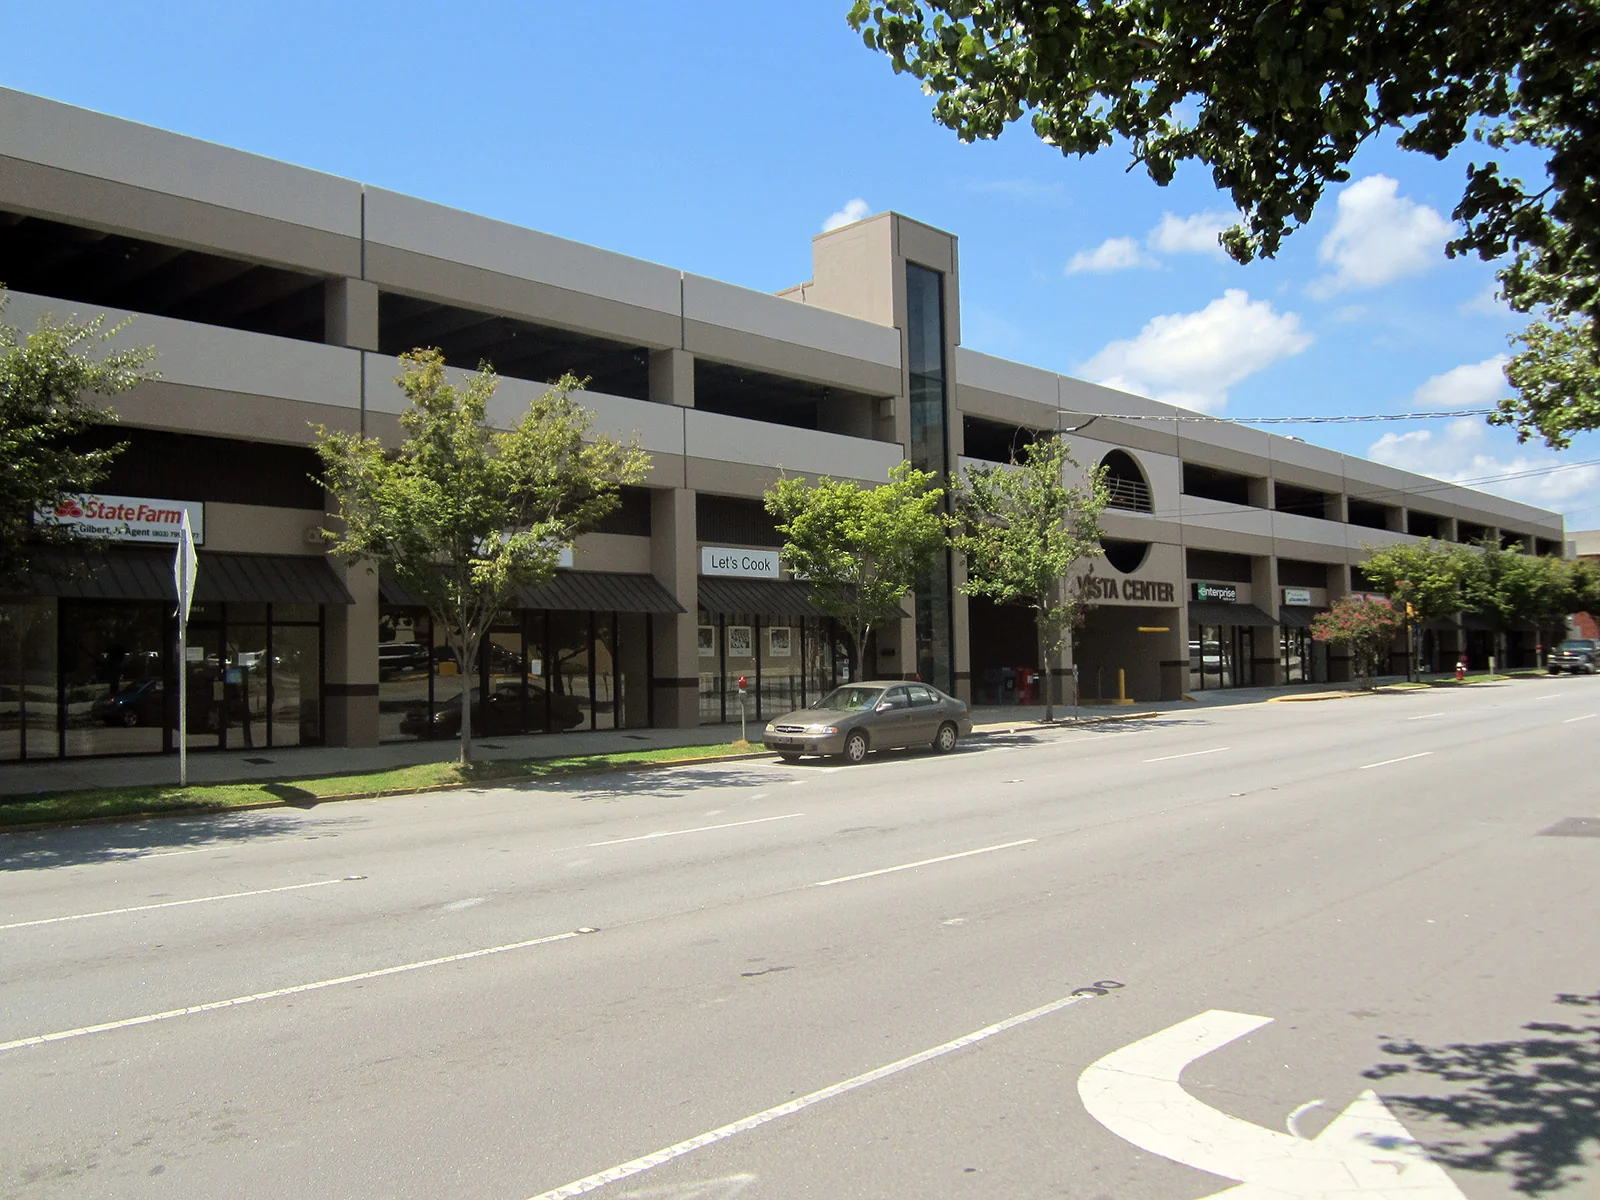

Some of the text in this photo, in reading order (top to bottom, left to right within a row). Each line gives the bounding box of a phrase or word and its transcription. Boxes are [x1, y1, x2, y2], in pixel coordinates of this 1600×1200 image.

[125, 526, 150, 537] Agent
[711, 554, 771, 571] Let's Cook
[1122, 579, 1174, 602] CENTER
[1198, 587, 1236, 599] enterprise
